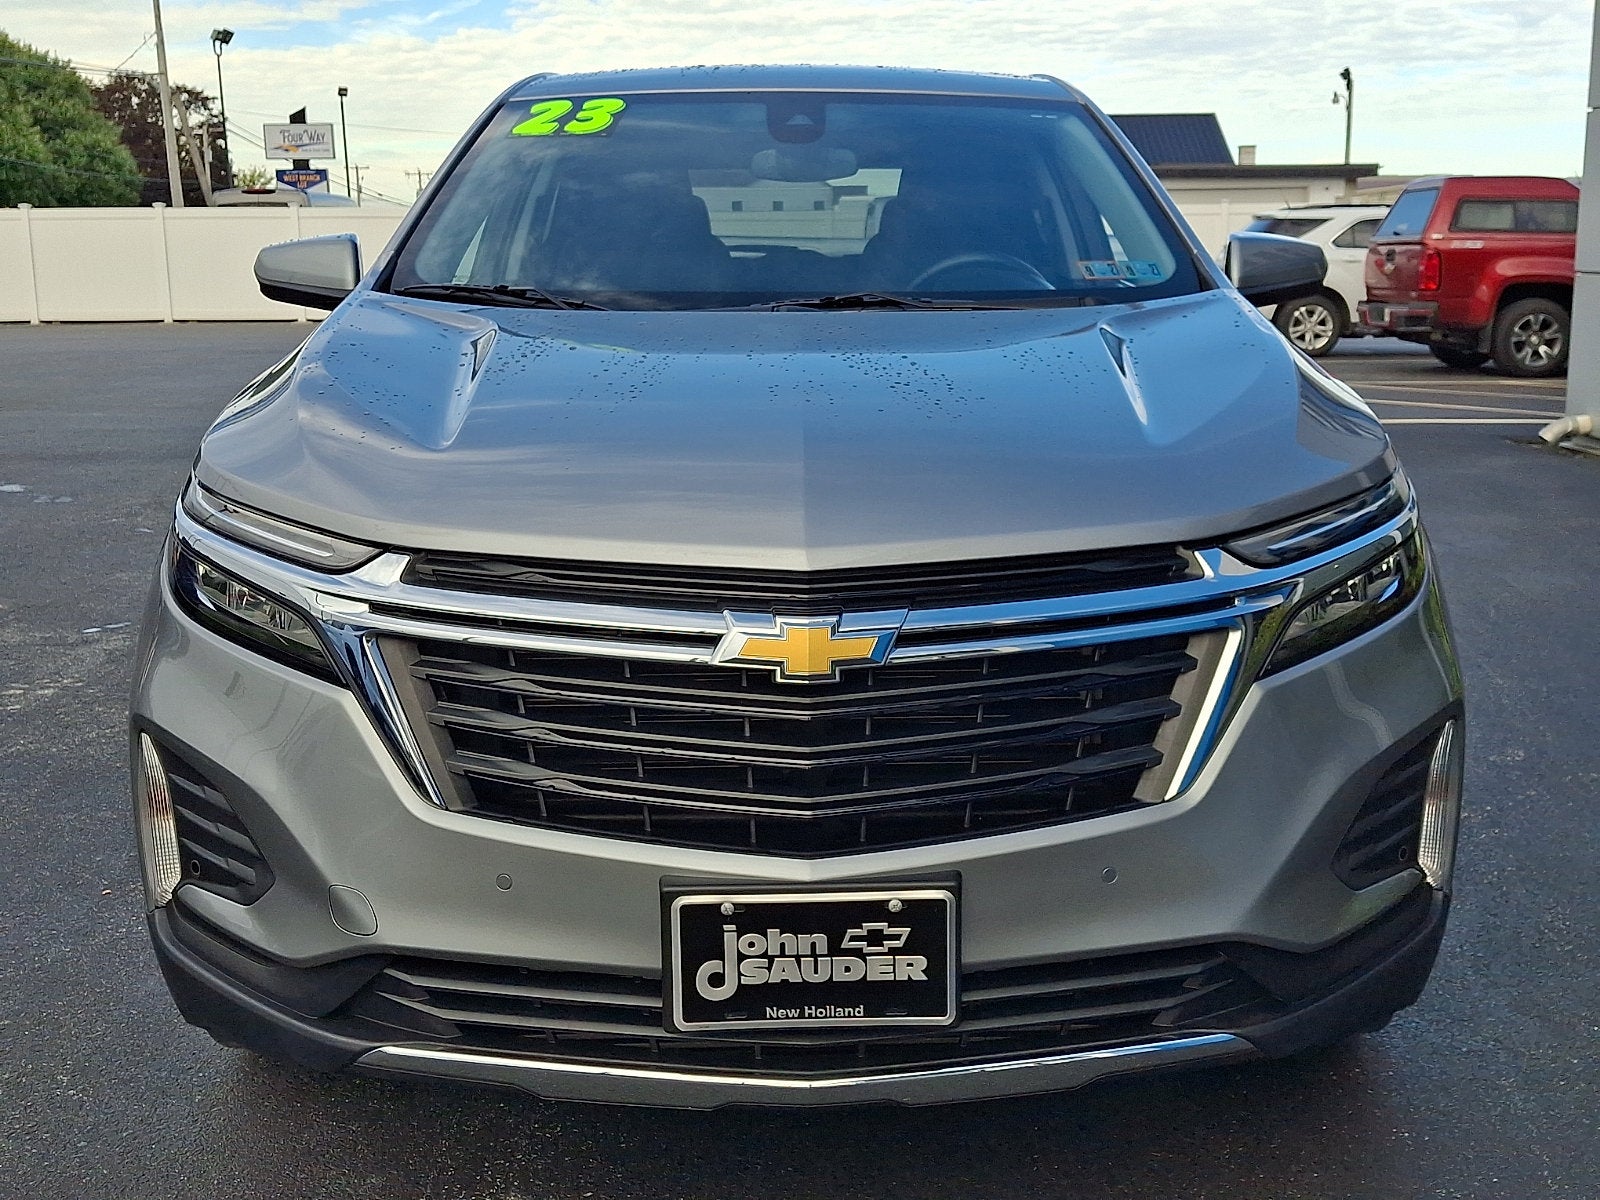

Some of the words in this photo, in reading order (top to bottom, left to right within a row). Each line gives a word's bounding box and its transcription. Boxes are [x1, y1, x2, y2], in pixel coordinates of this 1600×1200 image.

[511, 97, 626, 136] 23
[695, 924, 828, 1002] john
[739, 955, 929, 986] SAUDER
[766, 1006, 801, 1019] New
[804, 1005, 865, 1018] Holland
